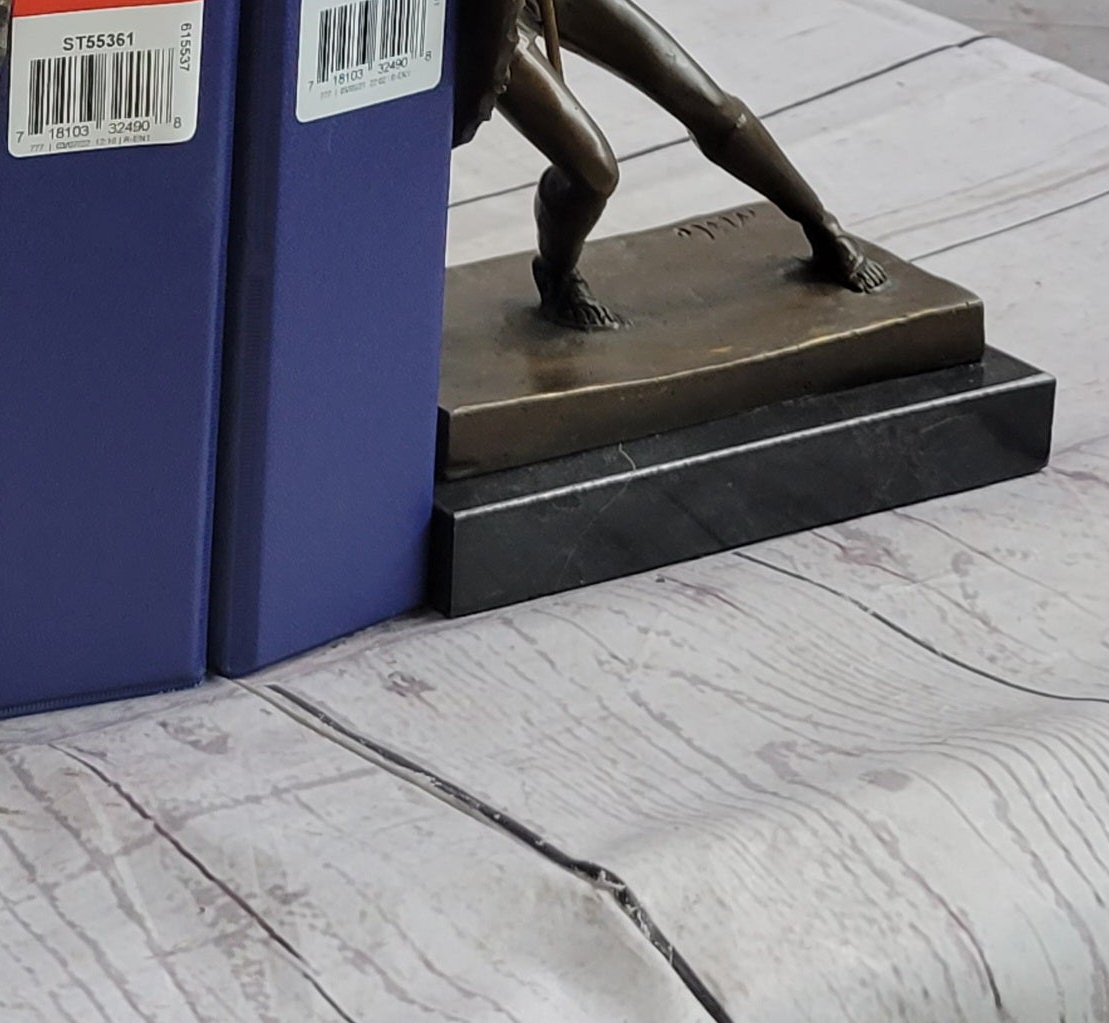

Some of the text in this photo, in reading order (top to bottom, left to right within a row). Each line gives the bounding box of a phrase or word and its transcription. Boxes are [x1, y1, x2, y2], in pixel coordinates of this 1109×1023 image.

[62, 32, 135, 51] ST55361
[179, 23, 192, 72] 615537
[332, 69, 364, 86] 18103
[16, 116, 182, 143] 7 18103 32490 8
